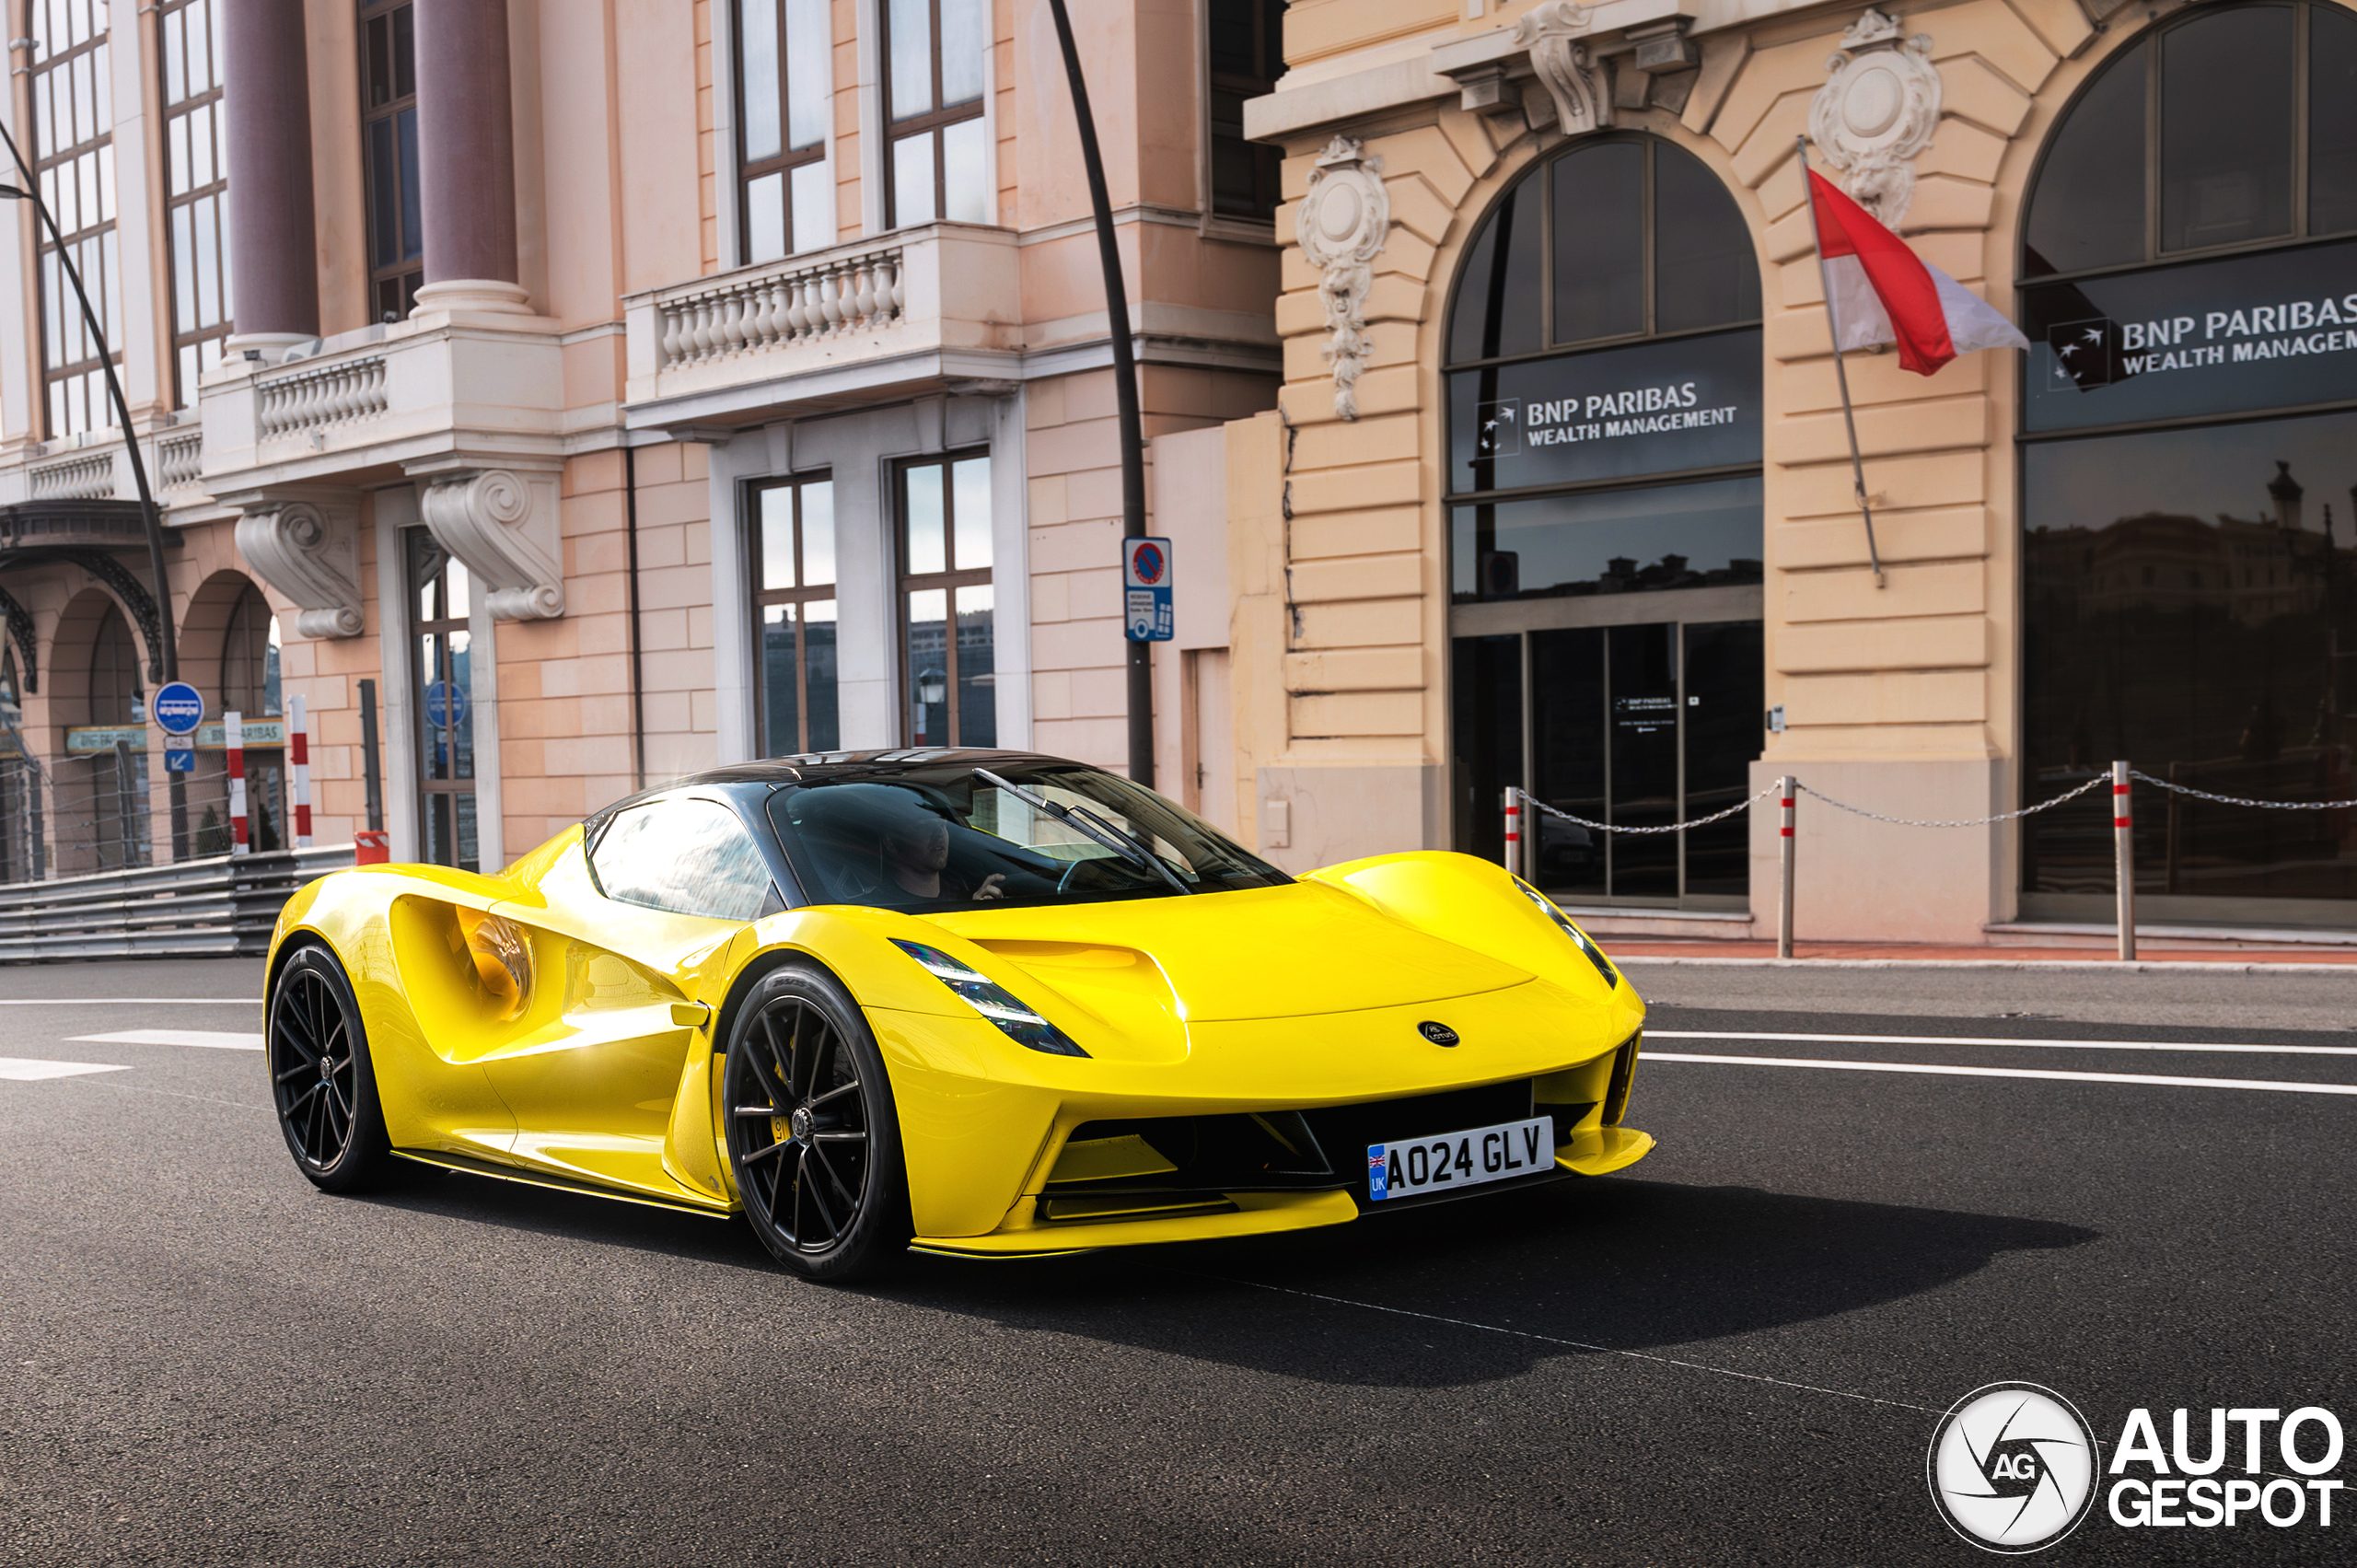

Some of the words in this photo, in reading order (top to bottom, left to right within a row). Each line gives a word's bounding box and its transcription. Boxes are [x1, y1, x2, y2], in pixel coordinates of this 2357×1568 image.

[2122, 316, 2196, 351] BNP
[2122, 344, 2224, 376] WEALTH
[1527, 398, 1579, 426] BNP
[1585, 381, 1698, 419] PARIBAS
[1527, 423, 1601, 447] WEALTH
[1605, 406, 1737, 437] MANAGEMENT
[1429, 1031, 1455, 1040] LOTUS
[1482, 1124, 1540, 1174] GLV
[1371, 1176, 1386, 1192] UK
